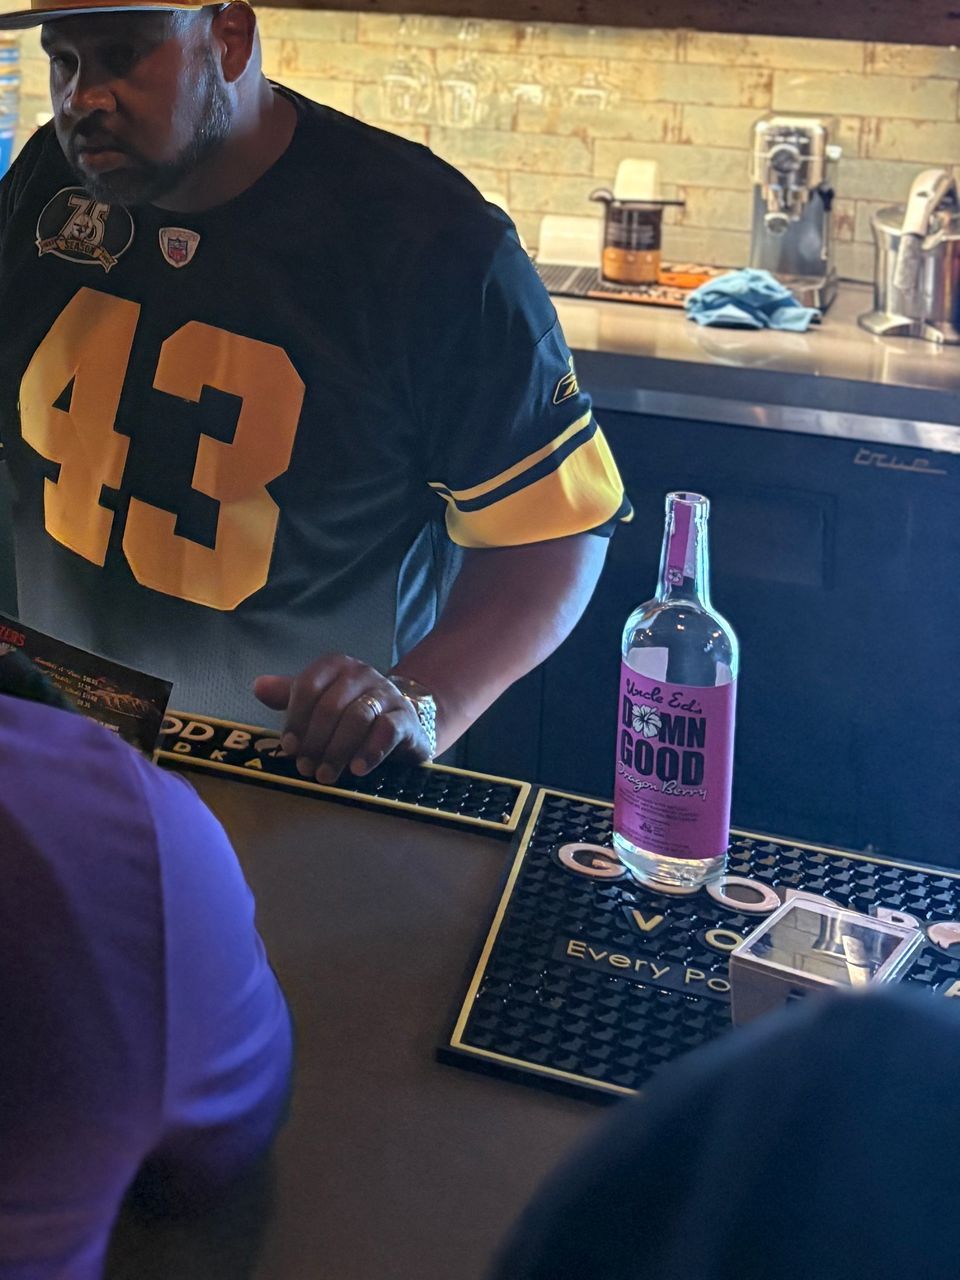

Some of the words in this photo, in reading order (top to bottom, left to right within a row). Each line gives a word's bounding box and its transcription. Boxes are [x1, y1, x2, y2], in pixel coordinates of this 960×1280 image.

[19, 286, 306, 611] 43
[626, 678, 663, 704] Uncle
[668, 692, 702, 715] Ed's
[620, 729, 706, 786] GOOD
[566, 939, 672, 980] Every
